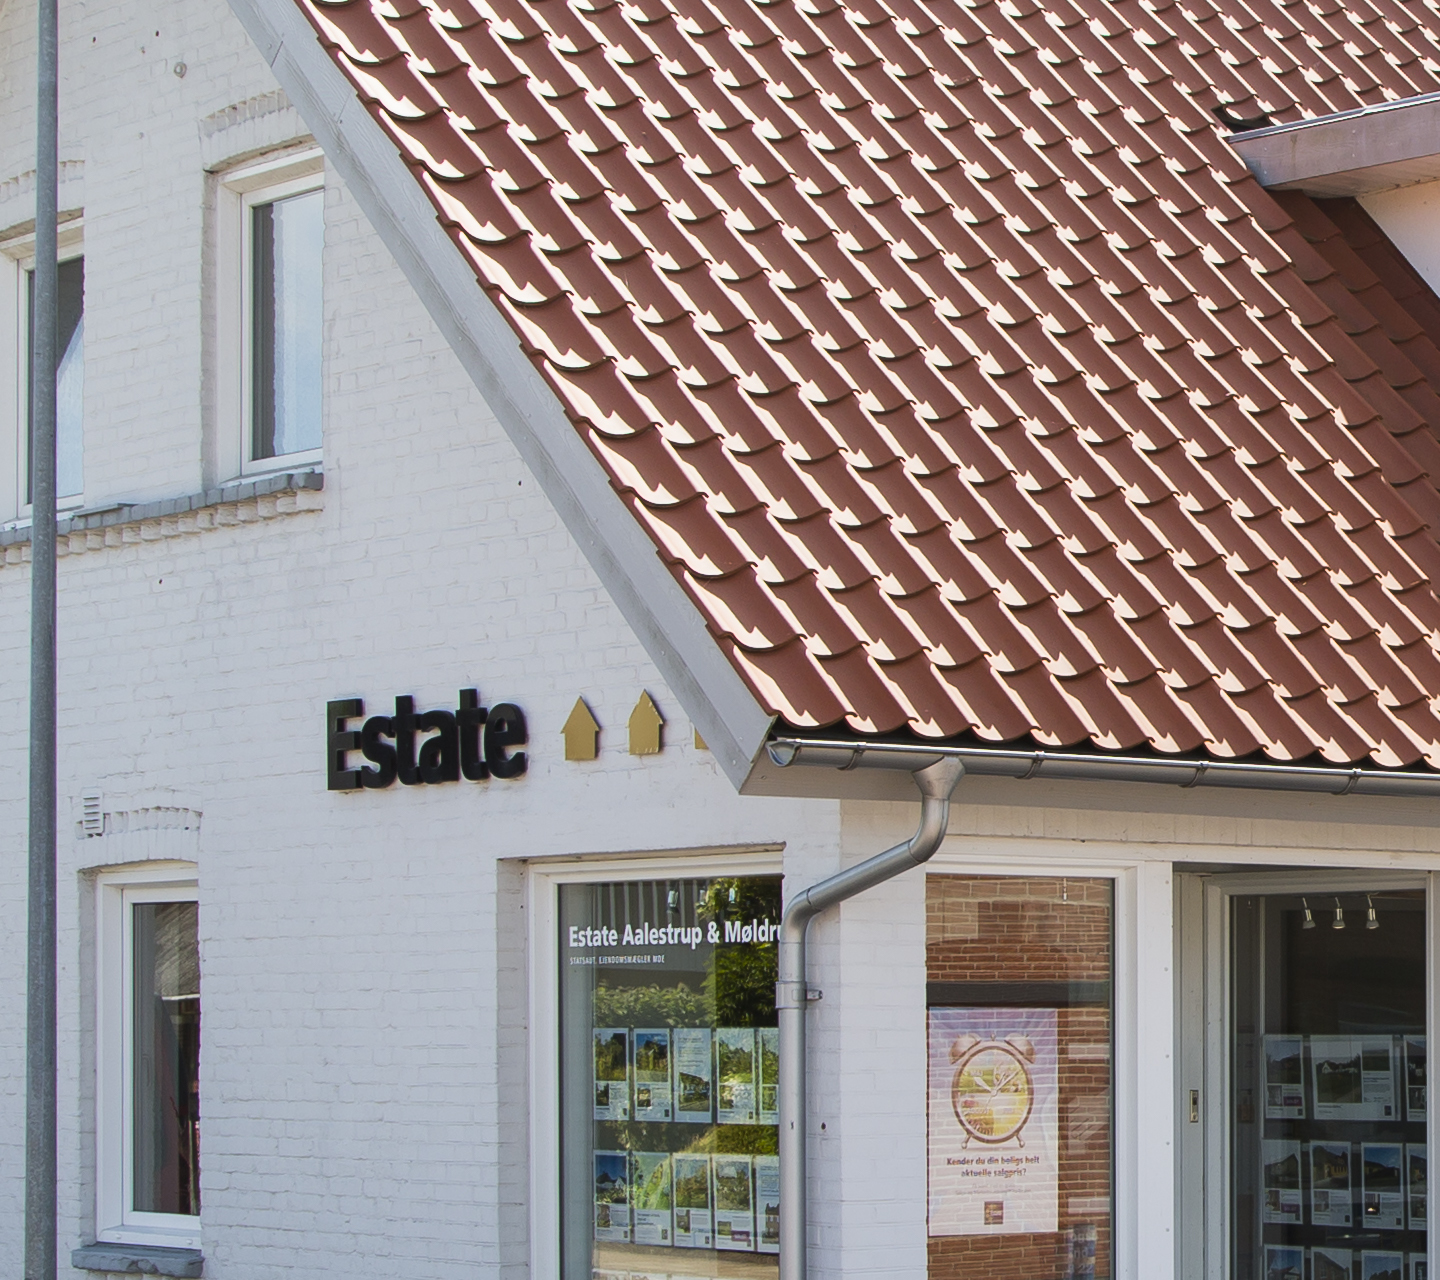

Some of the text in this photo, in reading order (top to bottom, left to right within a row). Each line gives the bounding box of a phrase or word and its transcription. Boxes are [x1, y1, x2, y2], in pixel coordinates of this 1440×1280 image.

[326, 688, 528, 790] Estate
[569, 926, 617, 947] Estate
[622, 922, 702, 949] Aalestrup
[708, 923, 719, 943] &
[946, 1157, 974, 1166] Kender
[976, 1157, 985, 1165] du
[987, 1156, 999, 1165] din
[961, 1168, 992, 1177] aktuelle
